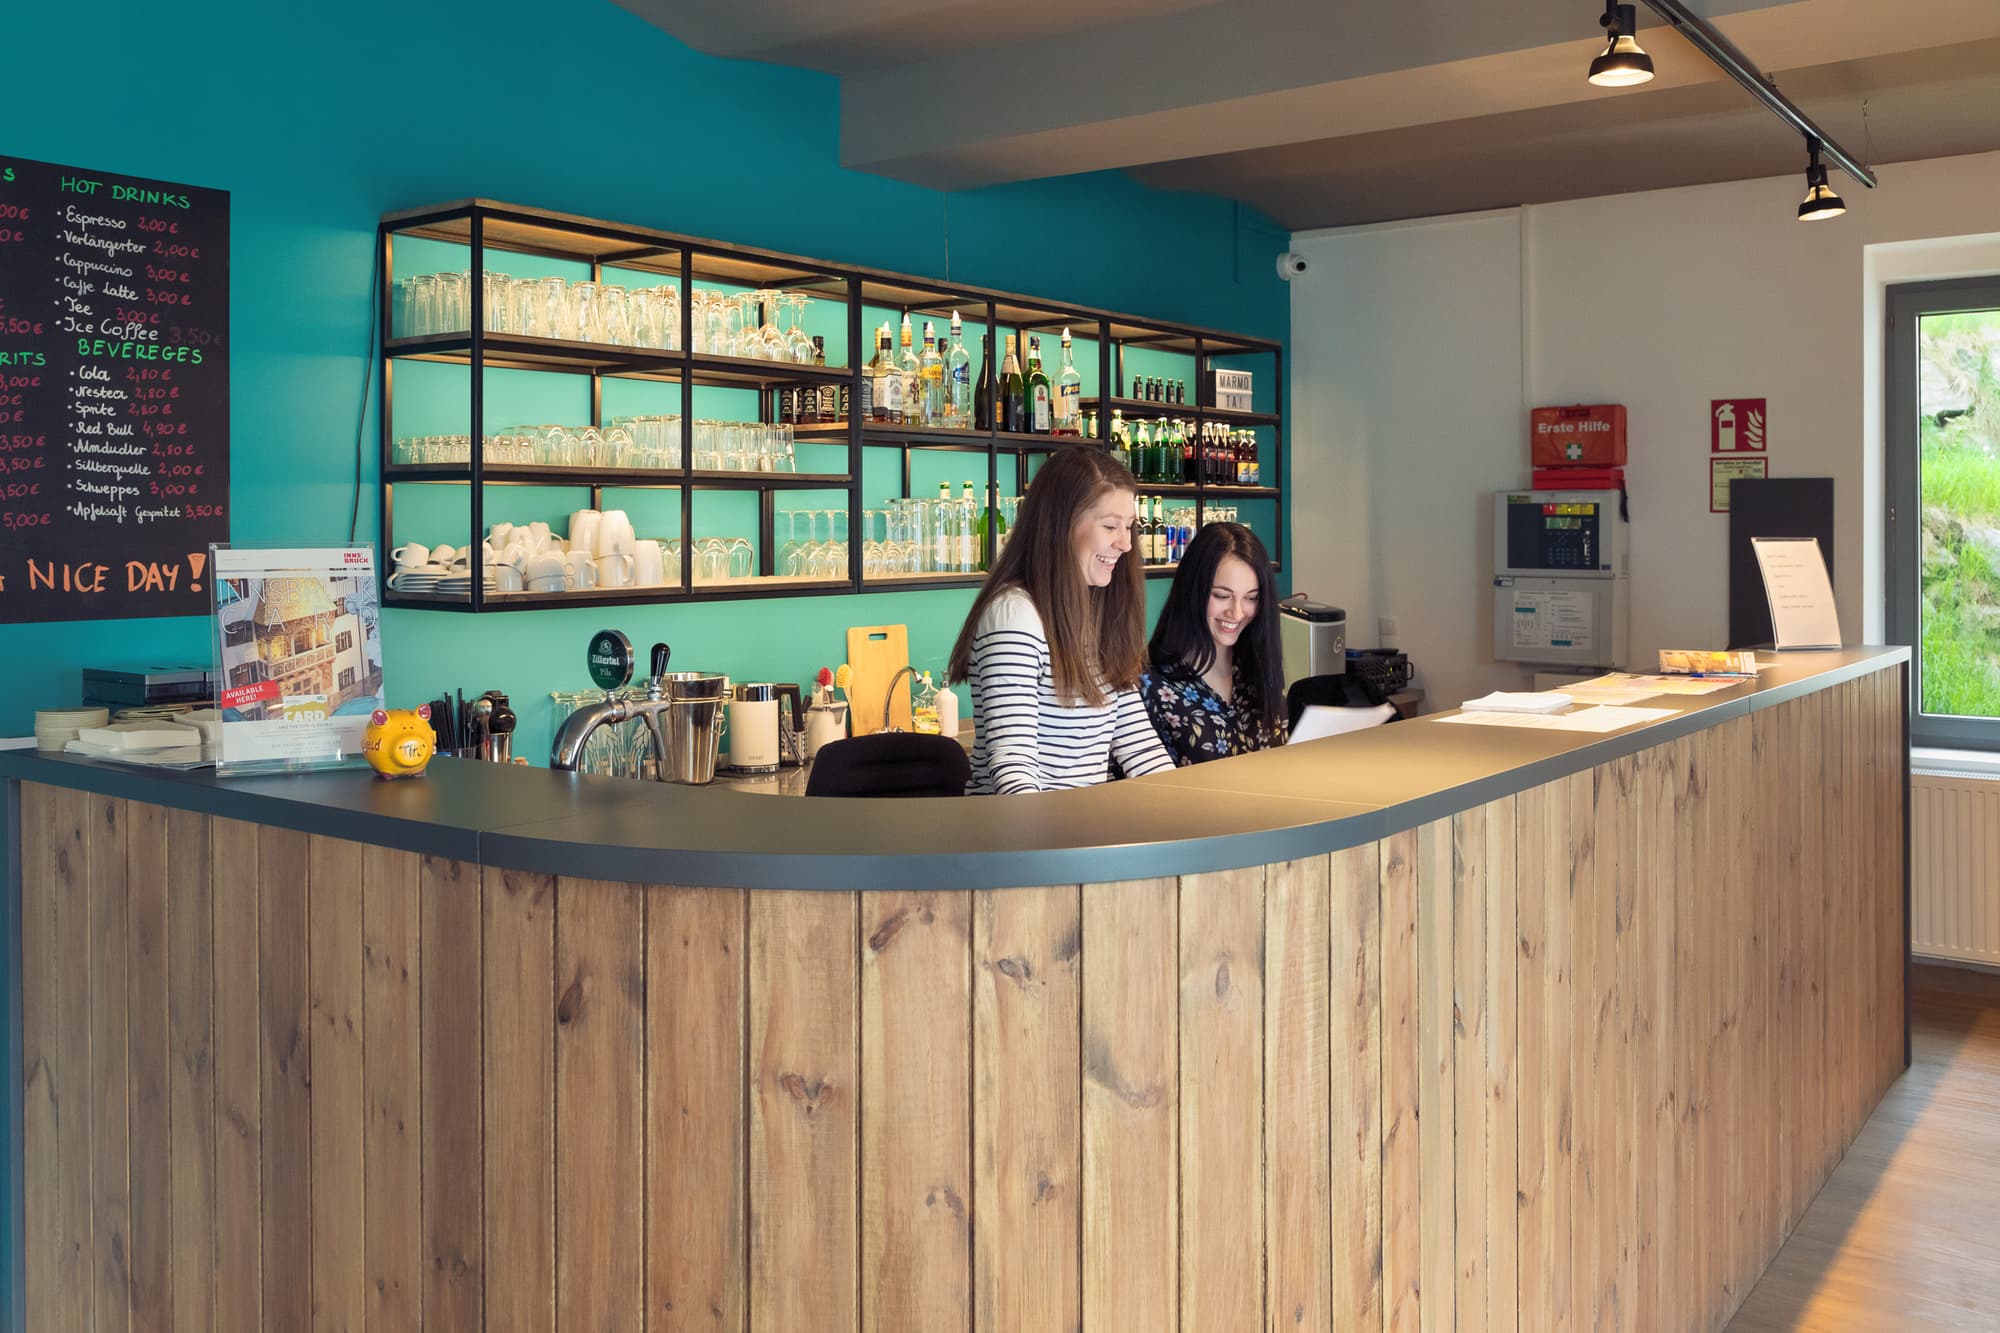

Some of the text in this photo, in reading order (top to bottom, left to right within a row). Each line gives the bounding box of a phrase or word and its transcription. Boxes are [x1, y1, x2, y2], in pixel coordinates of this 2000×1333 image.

[62, 176, 190, 208] HOT DRINKS
[66, 205, 126, 232] Espresso
[64, 230, 147, 257] Verlängerter
[63, 252, 133, 276] Cappuccino
[103, 281, 139, 301] Latte
[64, 296, 93, 315] Tee
[100, 318, 159, 341] Coffee
[78, 338, 203, 364] BEVEREGES
[79, 365, 111, 381] Cola
[1220, 375, 1249, 390] MARMO
[75, 385, 128, 400] Nestea
[75, 401, 117, 419] Sprite
[76, 421, 102, 435] Red
[107, 423, 134, 436] Bull
[1538, 420, 1610, 433] Erste Hilfe
[74, 438, 147, 454] Almdudler
[75, 479, 140, 502] Schweppes
[73, 501, 128, 524] Apfelsaft
[27, 558, 110, 592] NICE
[592, 654, 620, 666] Zillertal
[225, 684, 265, 699] AVAILABLE
[236, 694, 257, 704] HERE!
